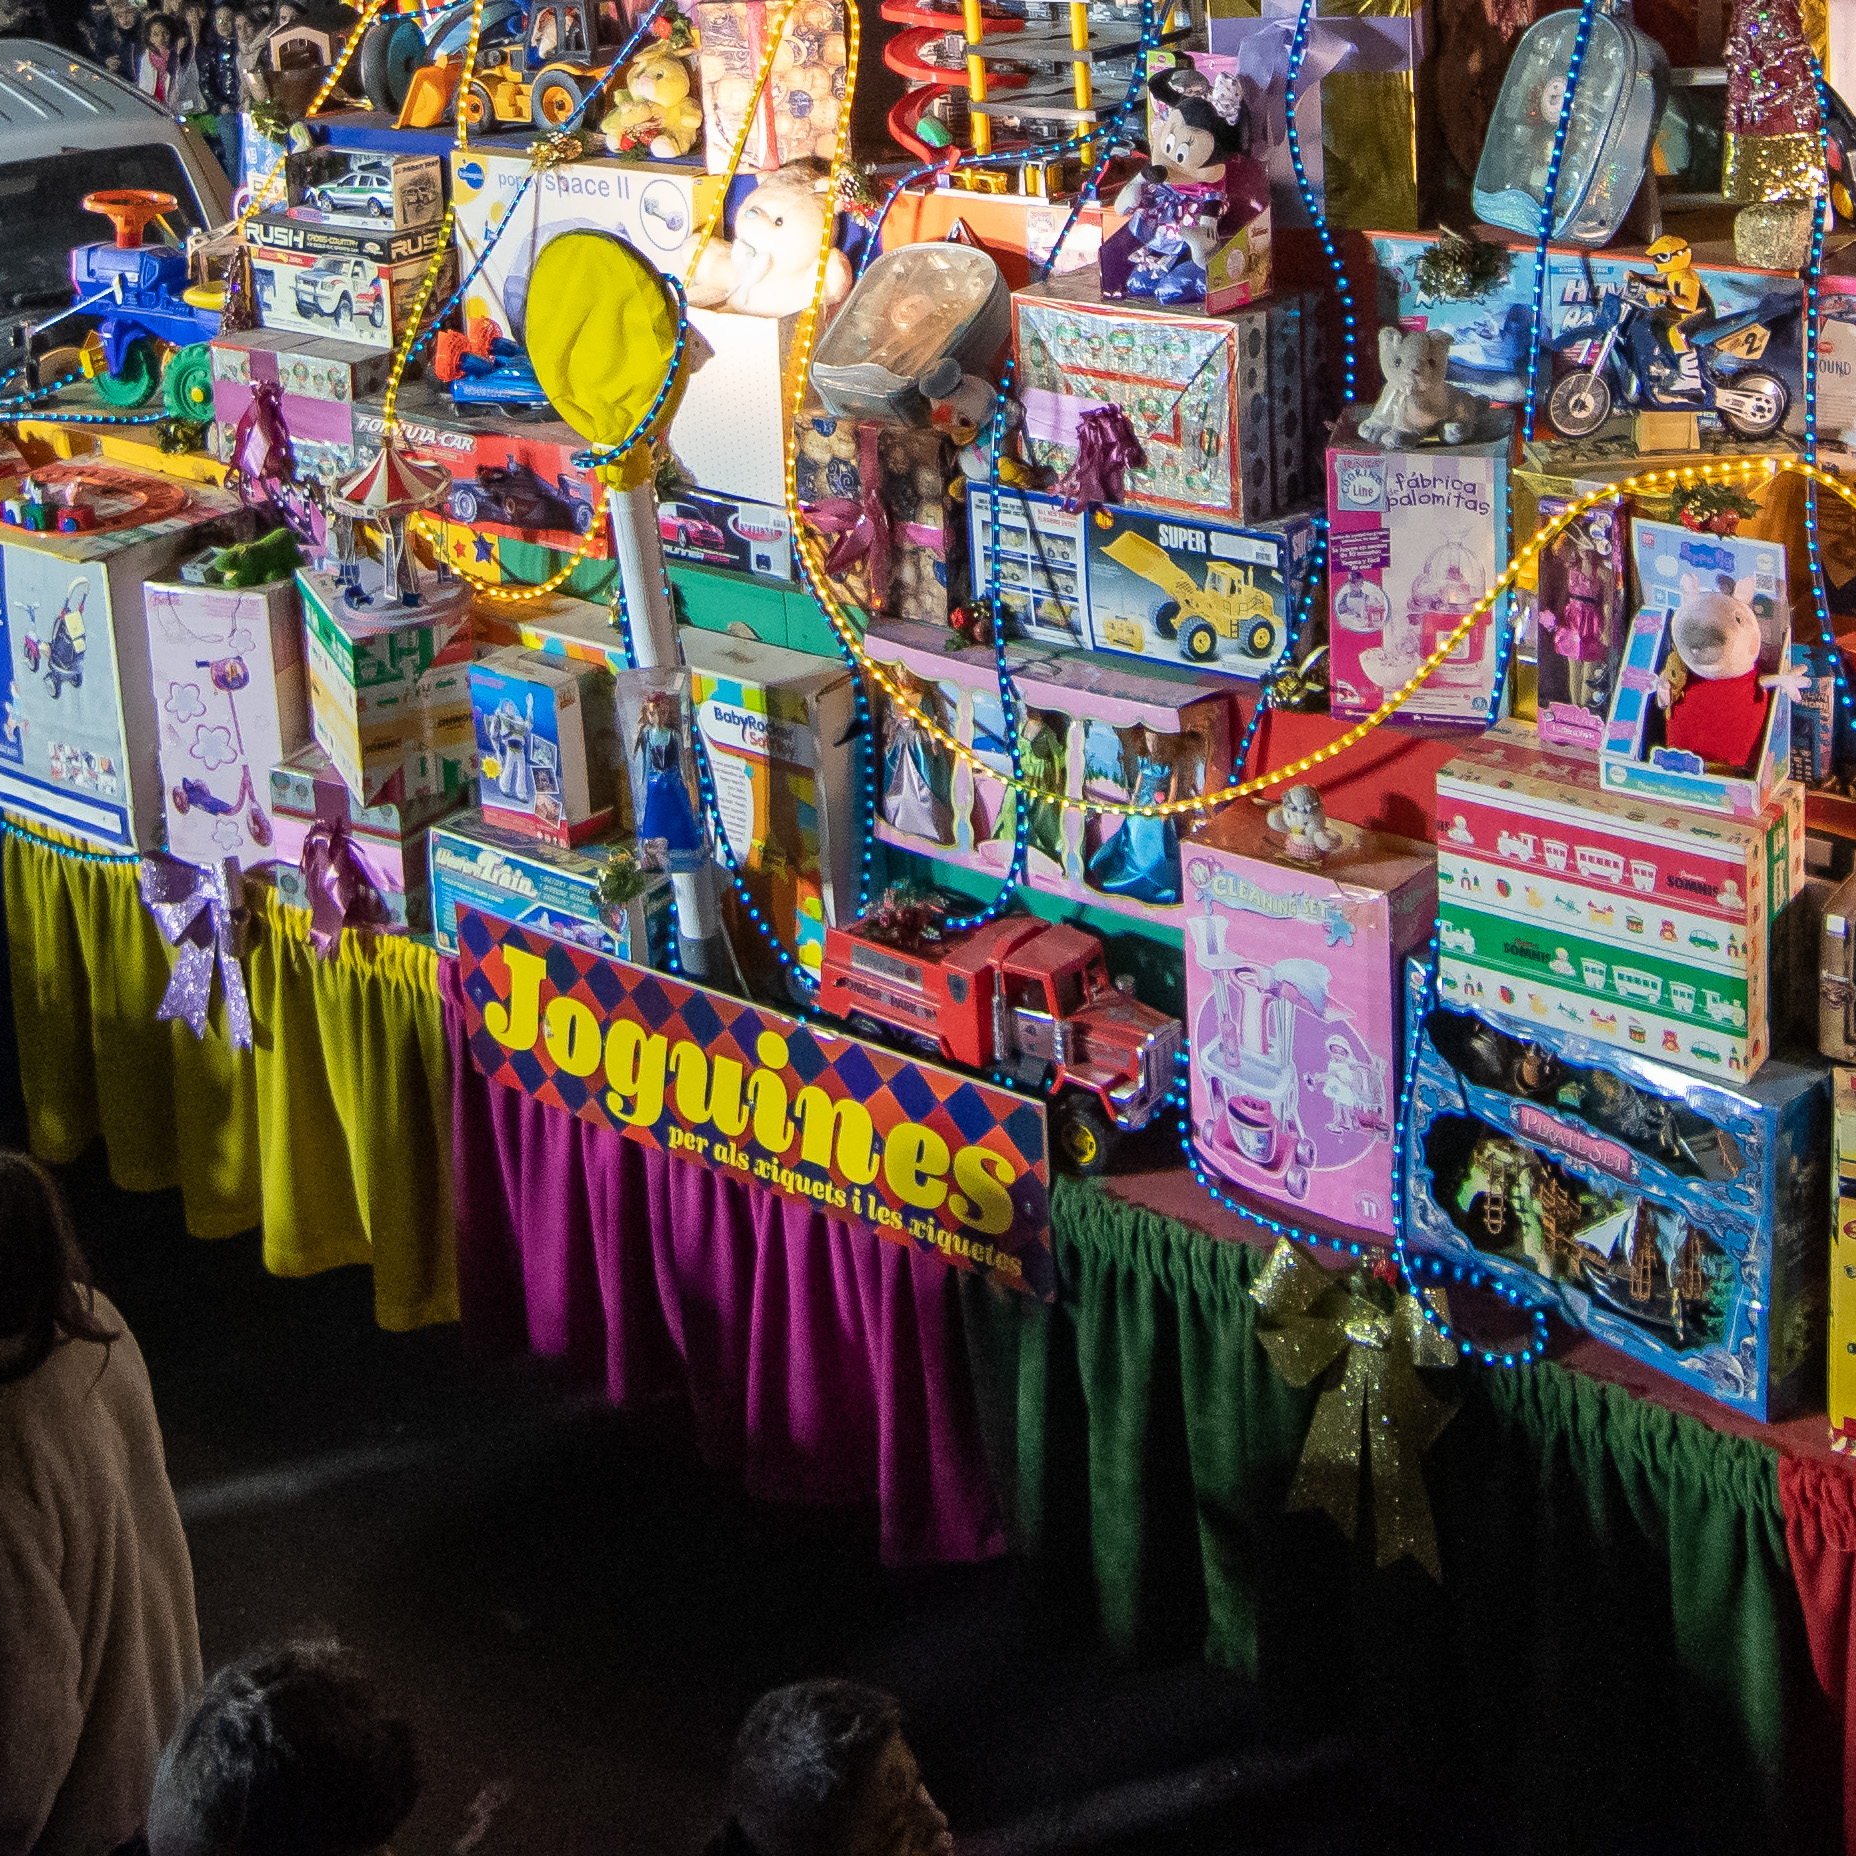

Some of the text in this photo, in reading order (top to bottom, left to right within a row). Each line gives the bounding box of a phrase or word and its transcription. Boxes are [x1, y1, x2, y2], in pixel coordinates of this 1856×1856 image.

[545, 175, 610, 198] space
[246, 221, 305, 249] RUSH
[1743, 331, 1759, 355] 2
[1352, 484, 1374, 498] Line
[1395, 471, 1477, 495] fábrica
[1385, 492, 1491, 516] palomitas
[1158, 523, 1207, 554] SUPER
[1213, 875, 1328, 917] CLEANING SET
[484, 945, 1017, 1235] Joguines
[1523, 1111, 1624, 1170] PIRATE SET
[669, 1125, 708, 1154] per
[713, 1141, 749, 1170] als
[753, 1153, 847, 1208] xiquets
[851, 1188, 863, 1214] i
[867, 1194, 903, 1230] les
